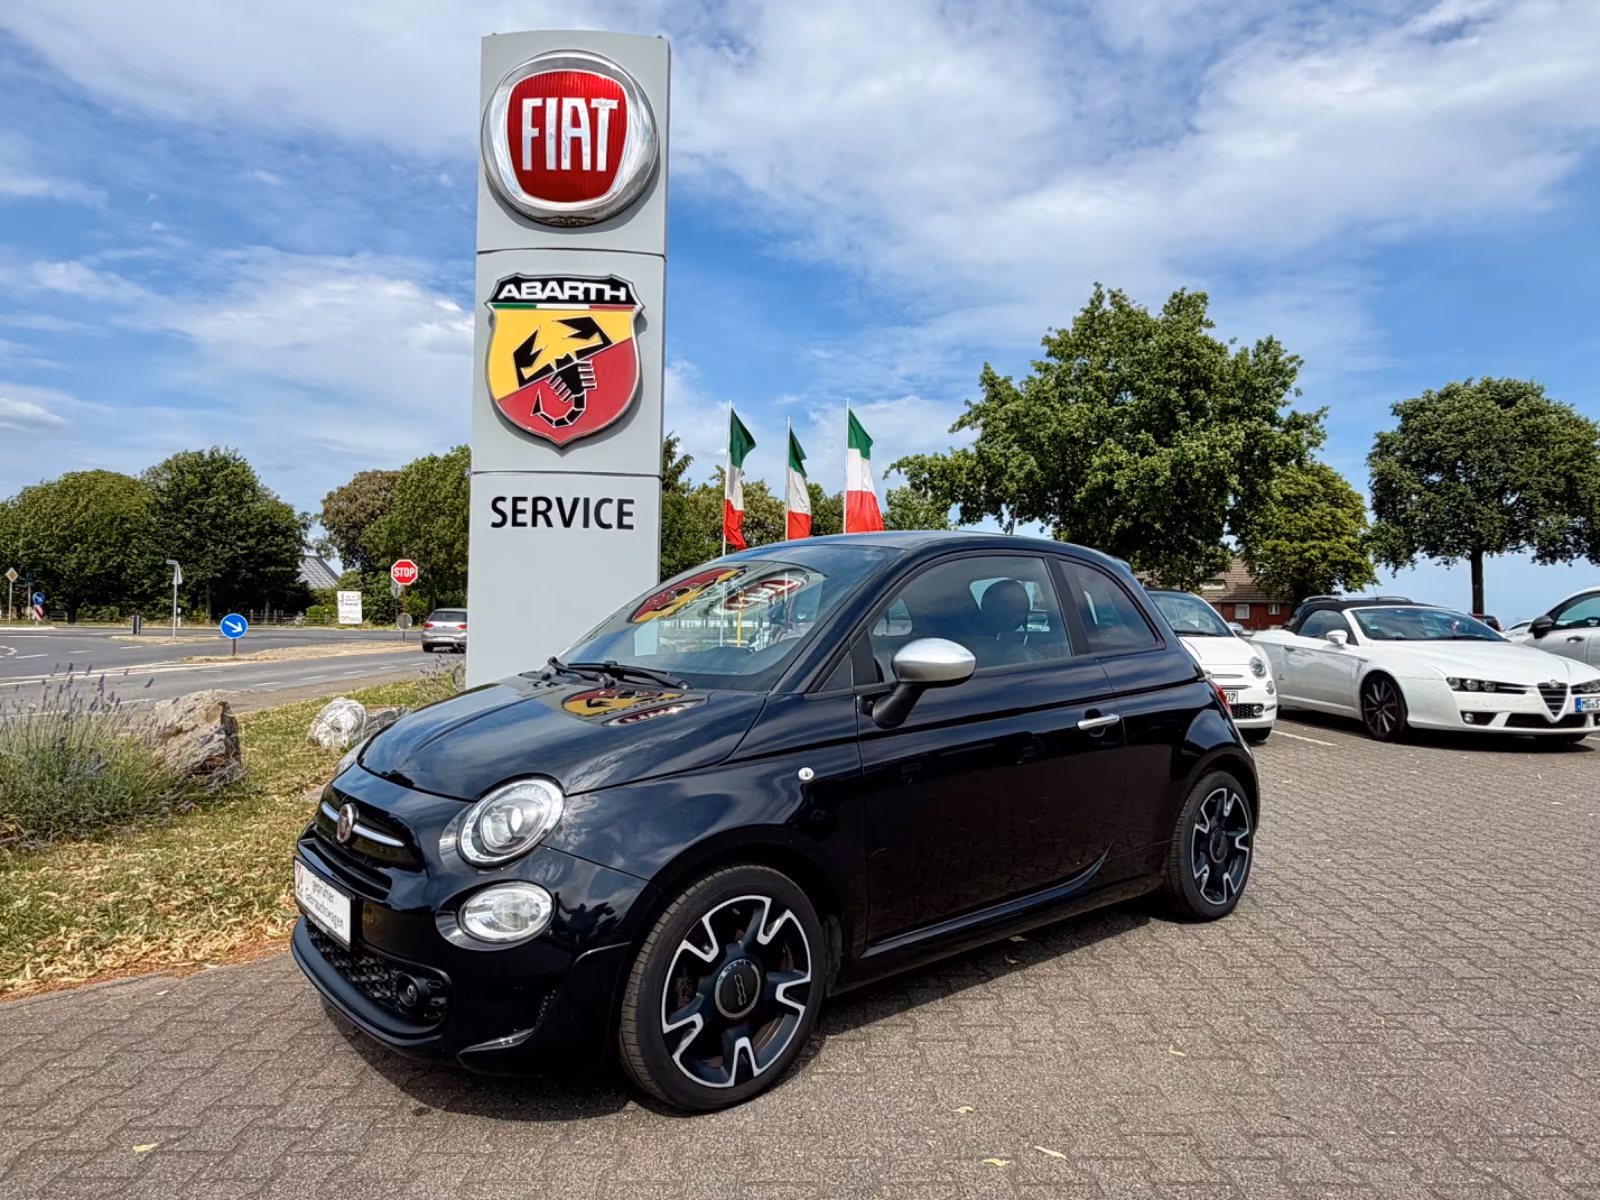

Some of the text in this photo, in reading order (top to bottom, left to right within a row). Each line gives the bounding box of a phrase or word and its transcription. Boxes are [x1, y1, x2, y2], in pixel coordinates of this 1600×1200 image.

[522, 97, 619, 172] FIAT
[498, 281, 627, 301] ABARTH
[490, 495, 635, 530] SERVICE
[393, 567, 415, 578] STOP
